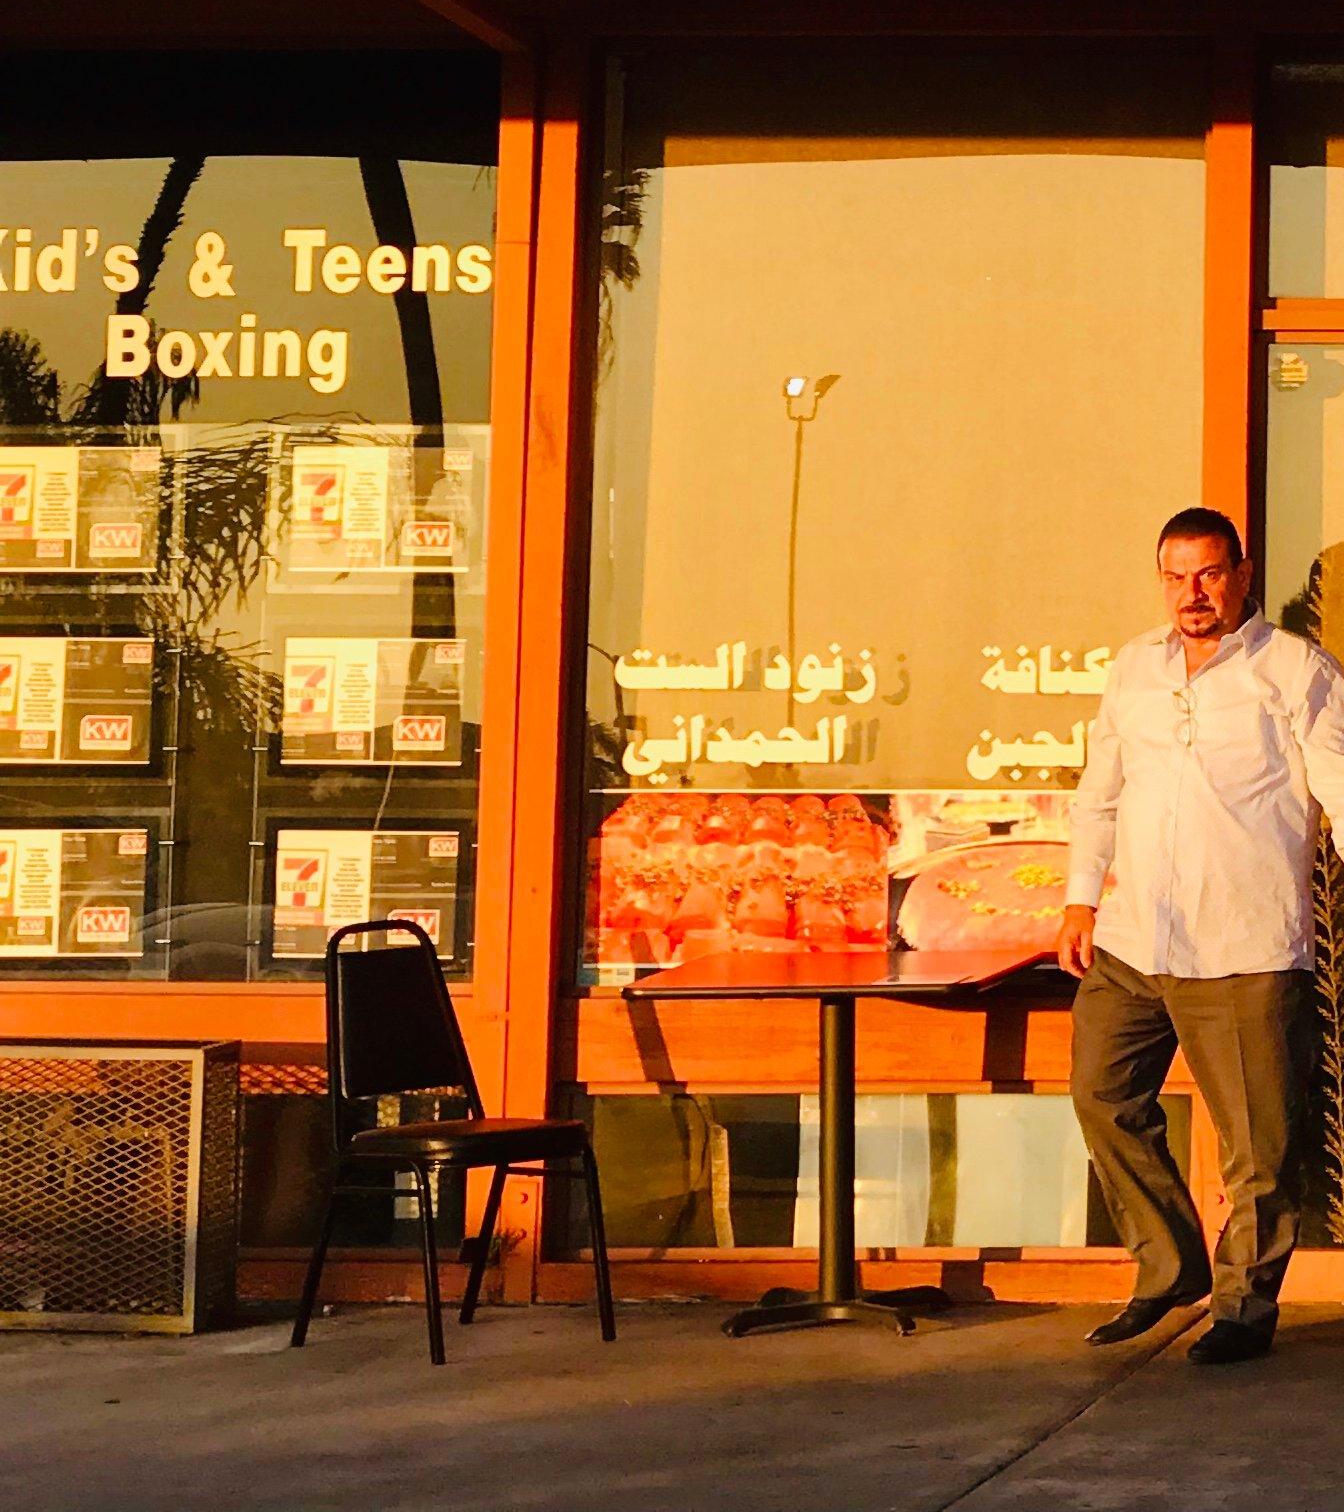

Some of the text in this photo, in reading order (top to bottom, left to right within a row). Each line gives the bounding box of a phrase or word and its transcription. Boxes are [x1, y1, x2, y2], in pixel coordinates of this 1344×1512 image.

[188, 231, 236, 297] &
[284, 228, 493, 294] Teens
[105, 314, 349, 394] Boxing
[94, 528, 137, 548] KW
[404, 527, 449, 547] KW
[614, 641, 876, 704] زنود الست
[84, 721, 127, 740] KW
[398, 721, 442, 741] KW
[622, 714, 847, 784] الحمداني
[284, 858, 320, 907] 7
[82, 914, 125, 933] KW
